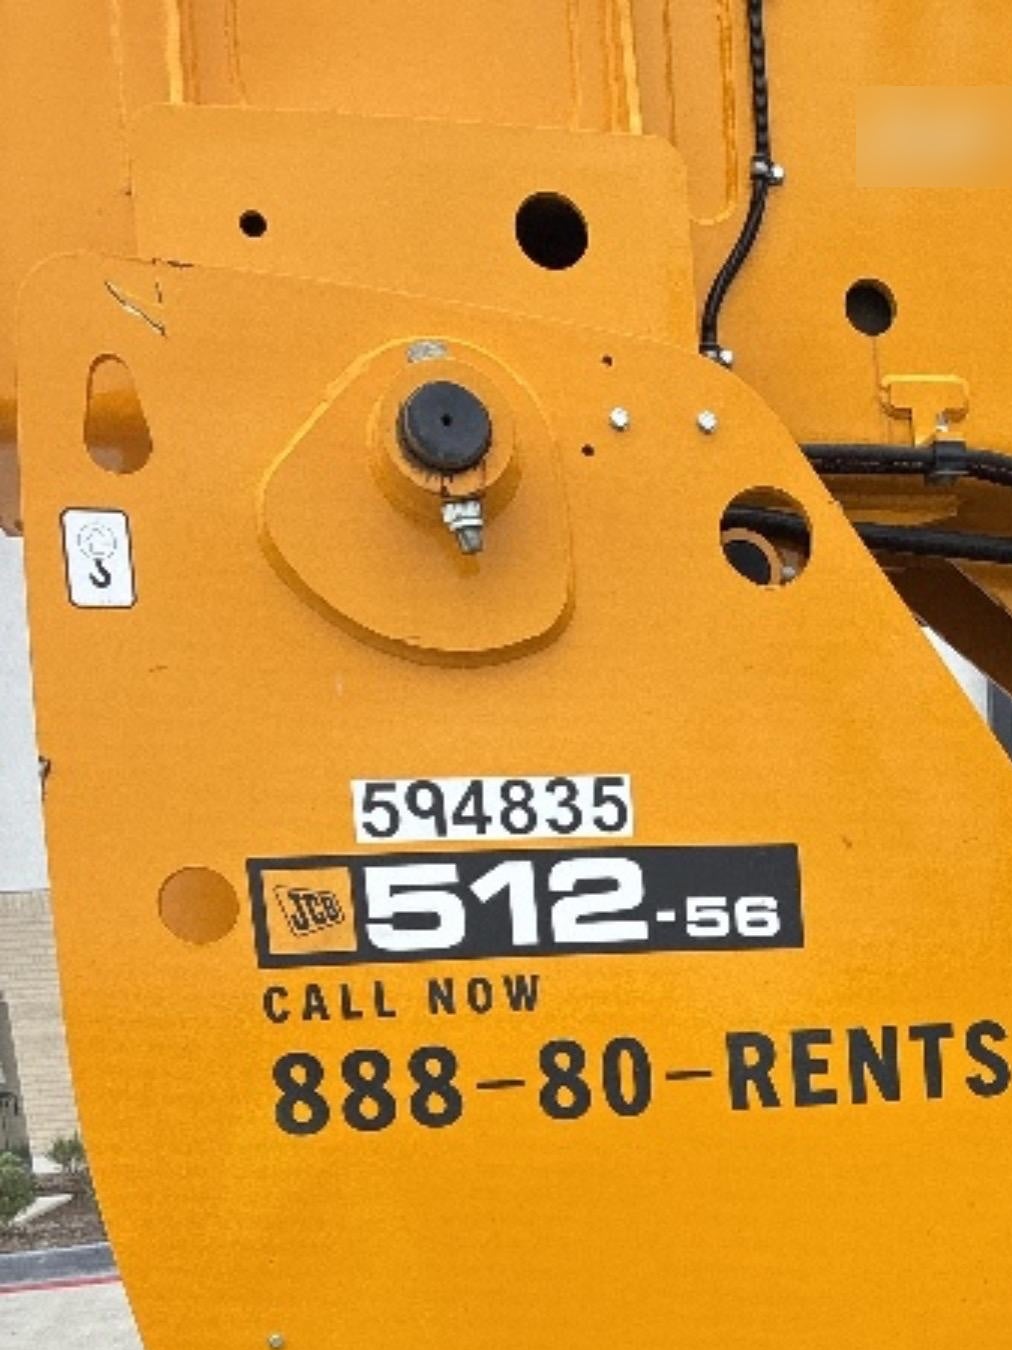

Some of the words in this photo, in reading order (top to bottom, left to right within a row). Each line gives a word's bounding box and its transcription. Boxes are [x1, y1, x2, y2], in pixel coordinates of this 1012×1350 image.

[361, 778, 629, 838] 594835
[288, 892, 340, 931] JCB
[364, 857, 781, 952] 512-56
[262, 982, 398, 1023] CALL
[428, 975, 541, 1014] NOW
[272, 1020, 1012, 1136] 888-80-RENTS
